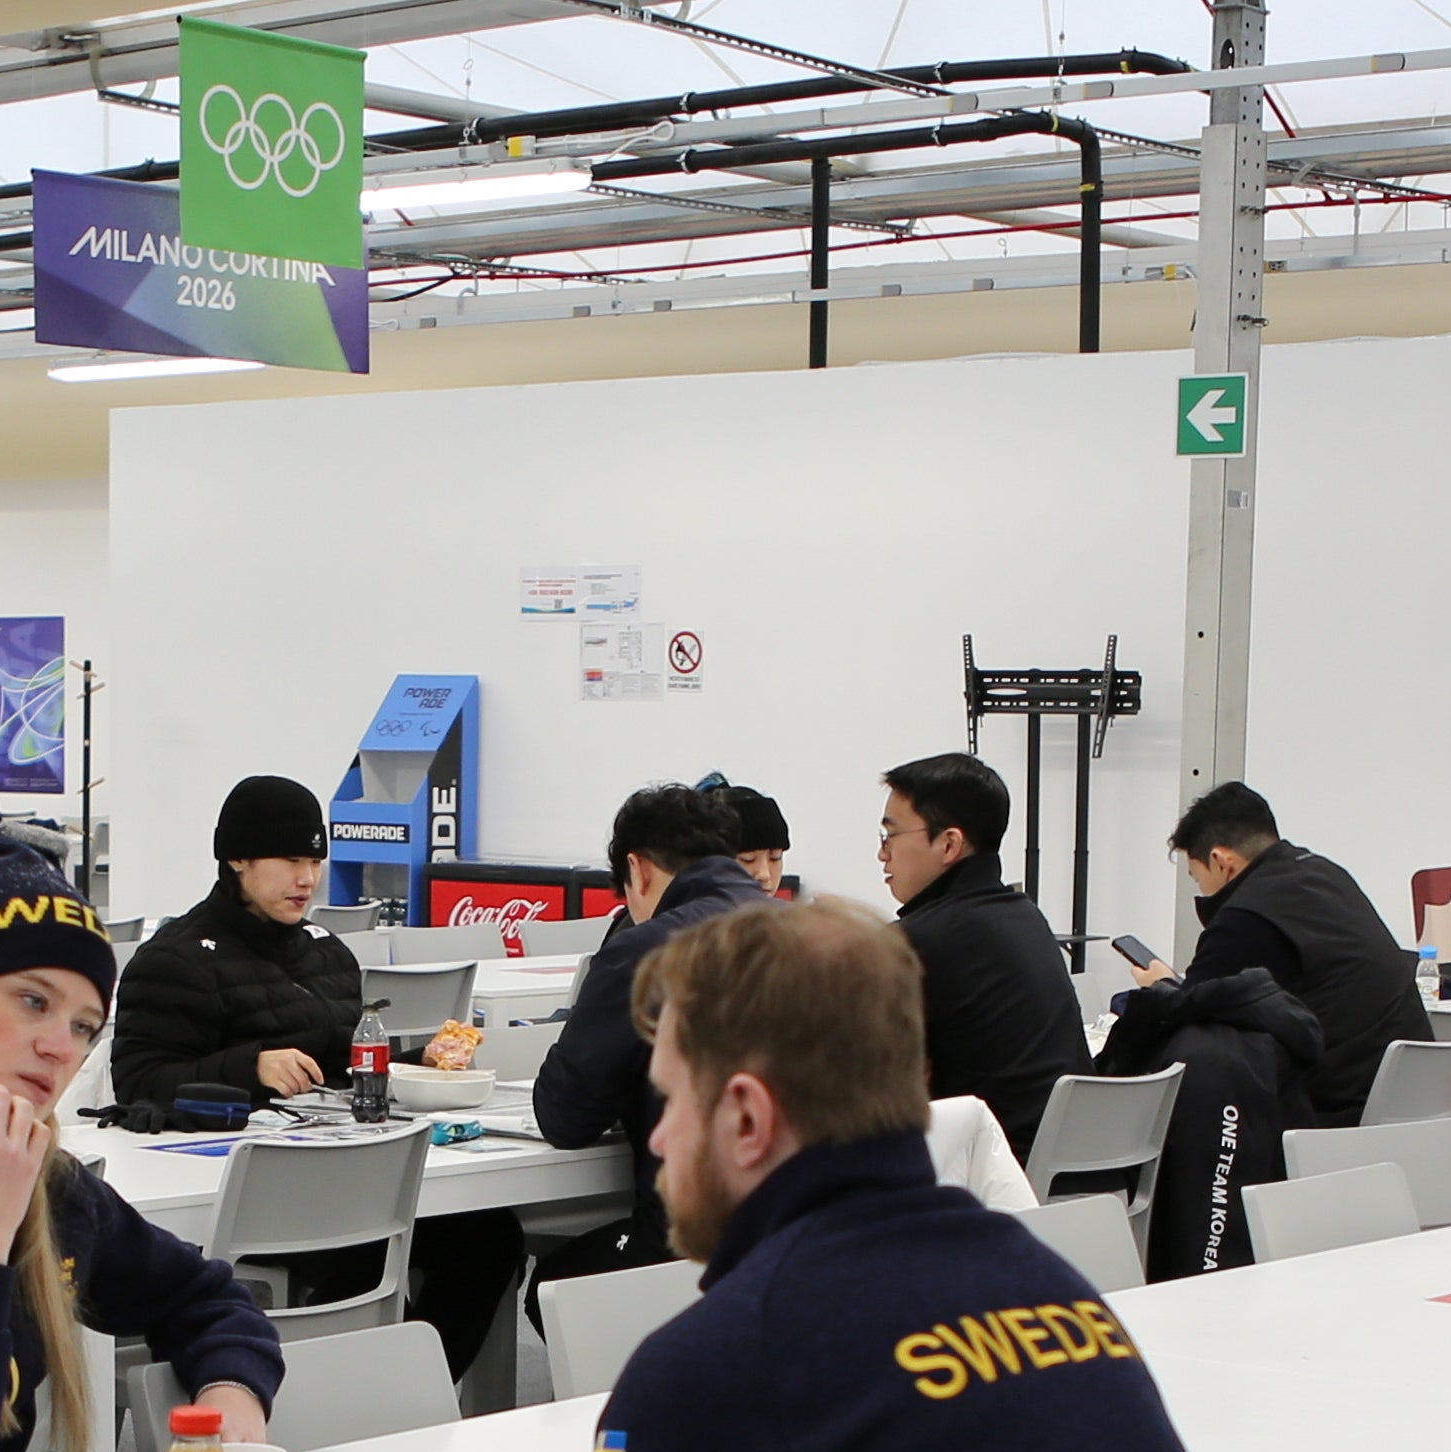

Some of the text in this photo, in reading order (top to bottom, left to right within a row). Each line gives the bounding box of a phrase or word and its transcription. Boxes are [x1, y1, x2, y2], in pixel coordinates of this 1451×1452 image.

[69, 225, 203, 269] MILANO
[177, 275, 236, 311] 2026
[404, 688, 452, 698] POWER
[418, 698, 447, 708] ADE
[333, 824, 406, 841] POWERADE
[1203, 1105, 1239, 1270] ONE TEAM KOREA
[894, 1300, 1130, 1400] SWEDE
